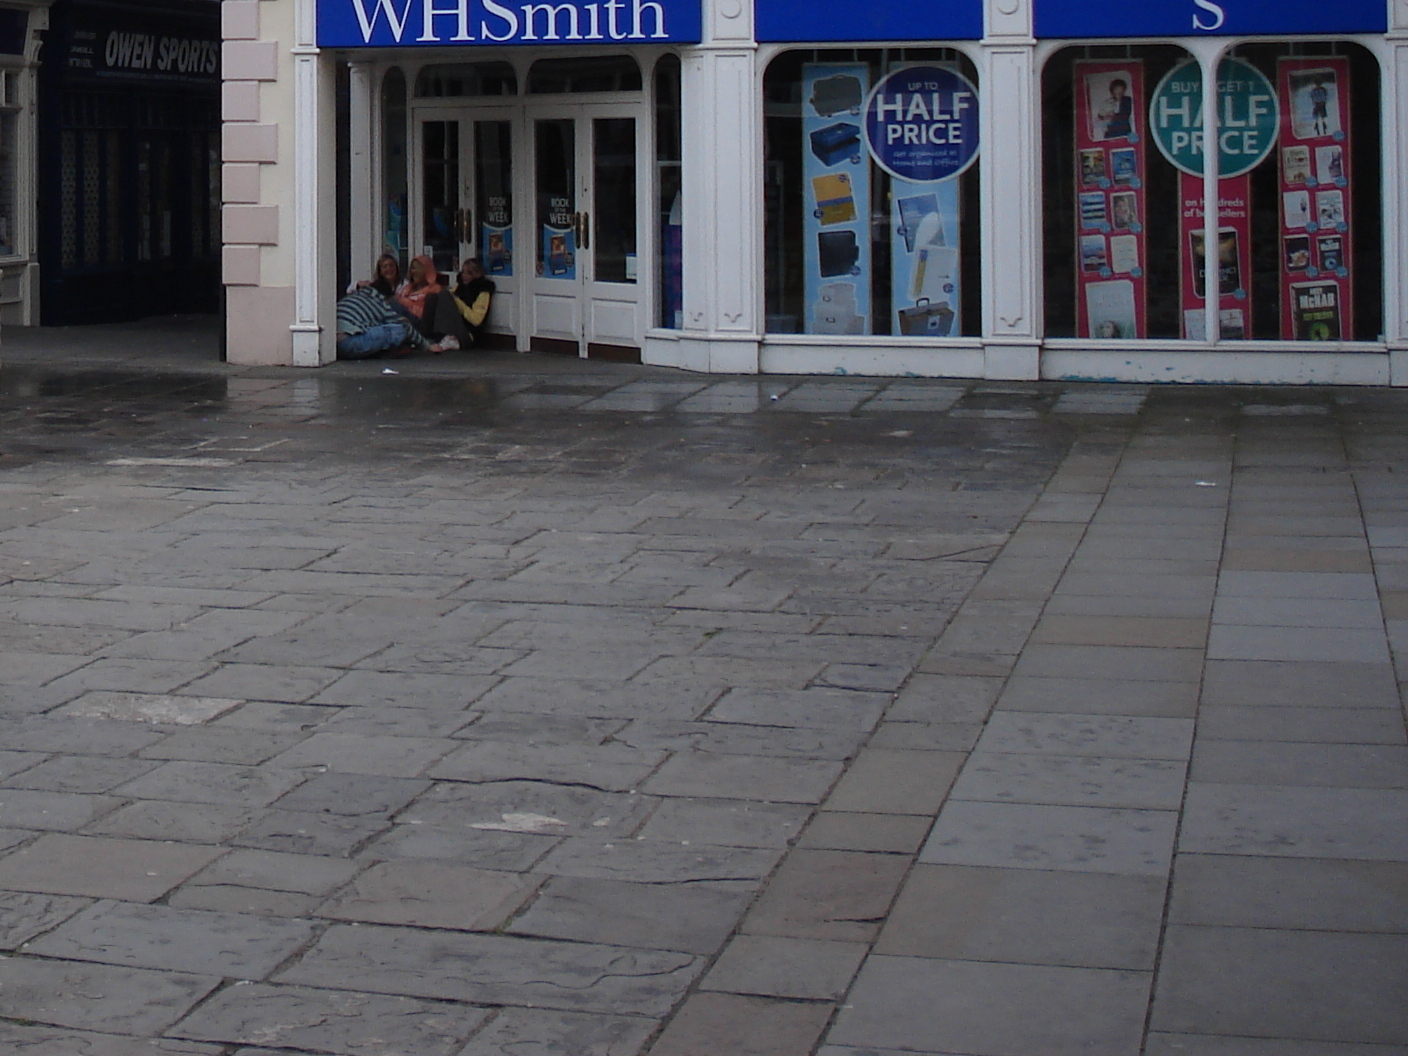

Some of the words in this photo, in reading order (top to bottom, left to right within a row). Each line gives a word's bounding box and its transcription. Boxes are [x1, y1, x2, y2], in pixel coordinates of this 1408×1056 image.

[105, 30, 155, 69] OWEN
[157, 36, 219, 74] SPORTS
[908, 82, 923, 91] UP
[925, 81, 939, 90] TO
[1172, 81, 1201, 93] BUY
[876, 92, 971, 122] HALF
[887, 122, 963, 145] PRICE
[1172, 130, 1260, 155] PRCE
[488, 211, 509, 223] WEEK
[549, 212, 572, 225] WEEK
